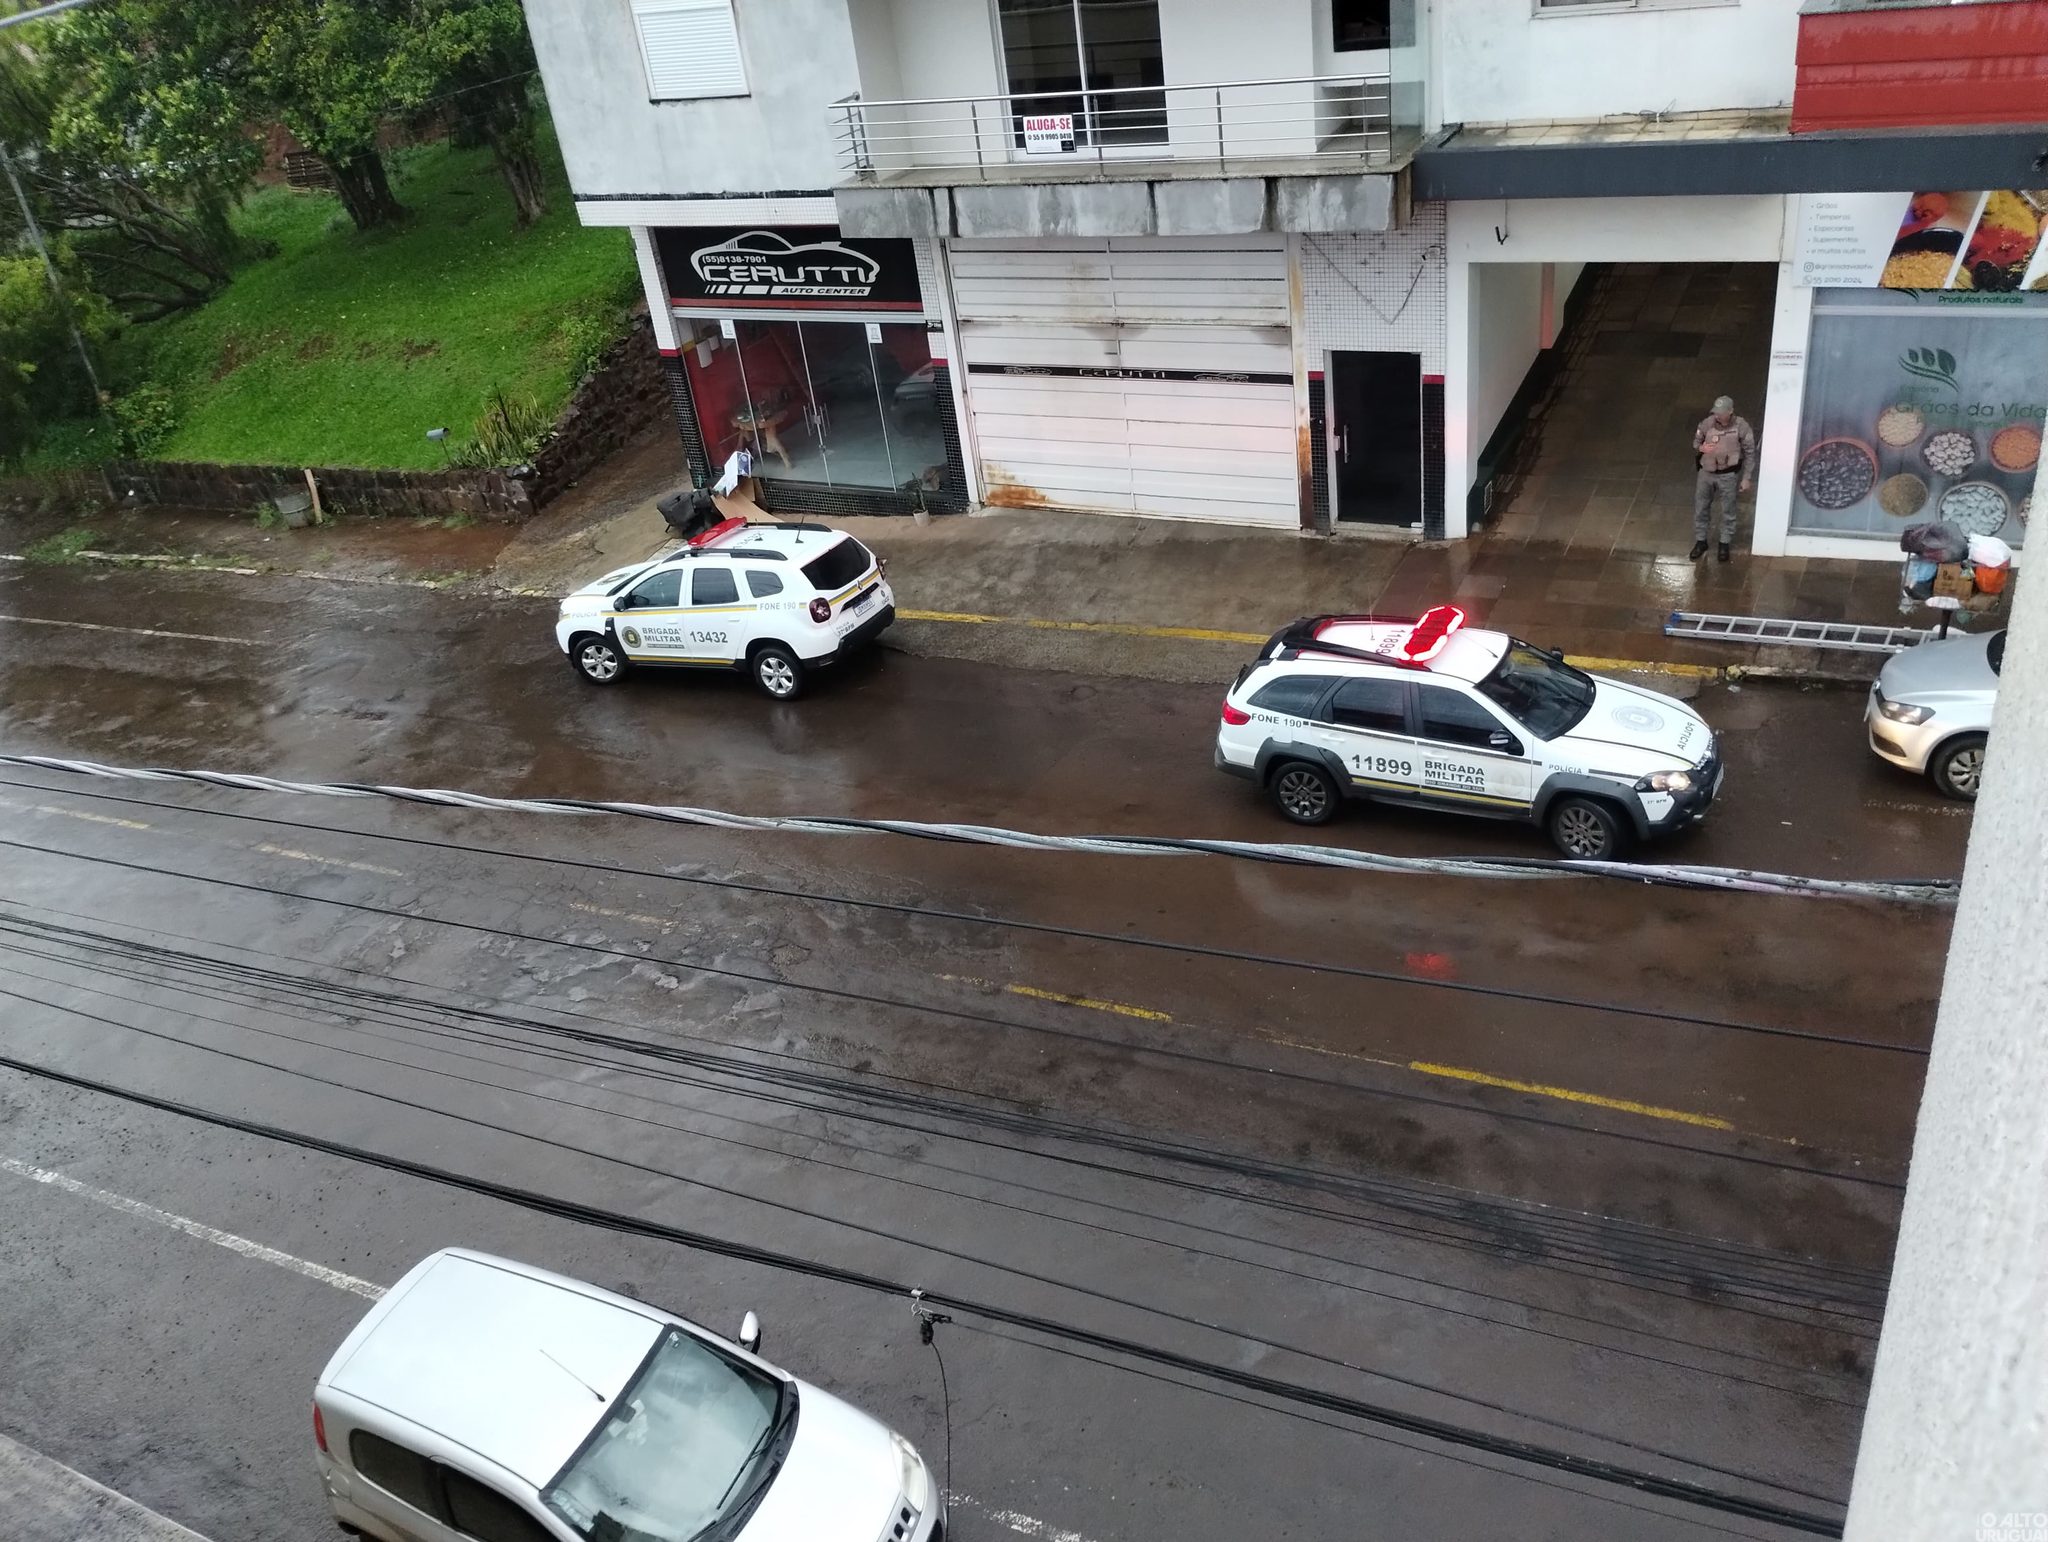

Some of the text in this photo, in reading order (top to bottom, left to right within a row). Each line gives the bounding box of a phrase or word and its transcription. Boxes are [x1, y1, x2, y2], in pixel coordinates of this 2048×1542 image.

[1026, 118, 1071, 131] ALUGA-SE
[702, 255, 767, 264] (55)8138-7901
[702, 265, 866, 283] CERUTTI
[781, 287, 866, 295] AUTO CENTER
[1938, 295, 2024, 304] Produtos naturais
[1967, 402, 1994, 417] da
[2001, 402, 2048, 419] Vida
[760, 602, 796, 610] FONE 190
[642, 627, 680, 635] BRIGADA
[690, 631, 728, 643] 13432
[644, 635, 682, 643] MILITAR
[1375, 629, 1406, 654] 11899
[1251, 713, 1302, 728] FONE 190
[1352, 754, 1412, 776] 11899
[1425, 760, 1485, 776] BRIGADA
[1425, 770, 1485, 785] MILITAR
